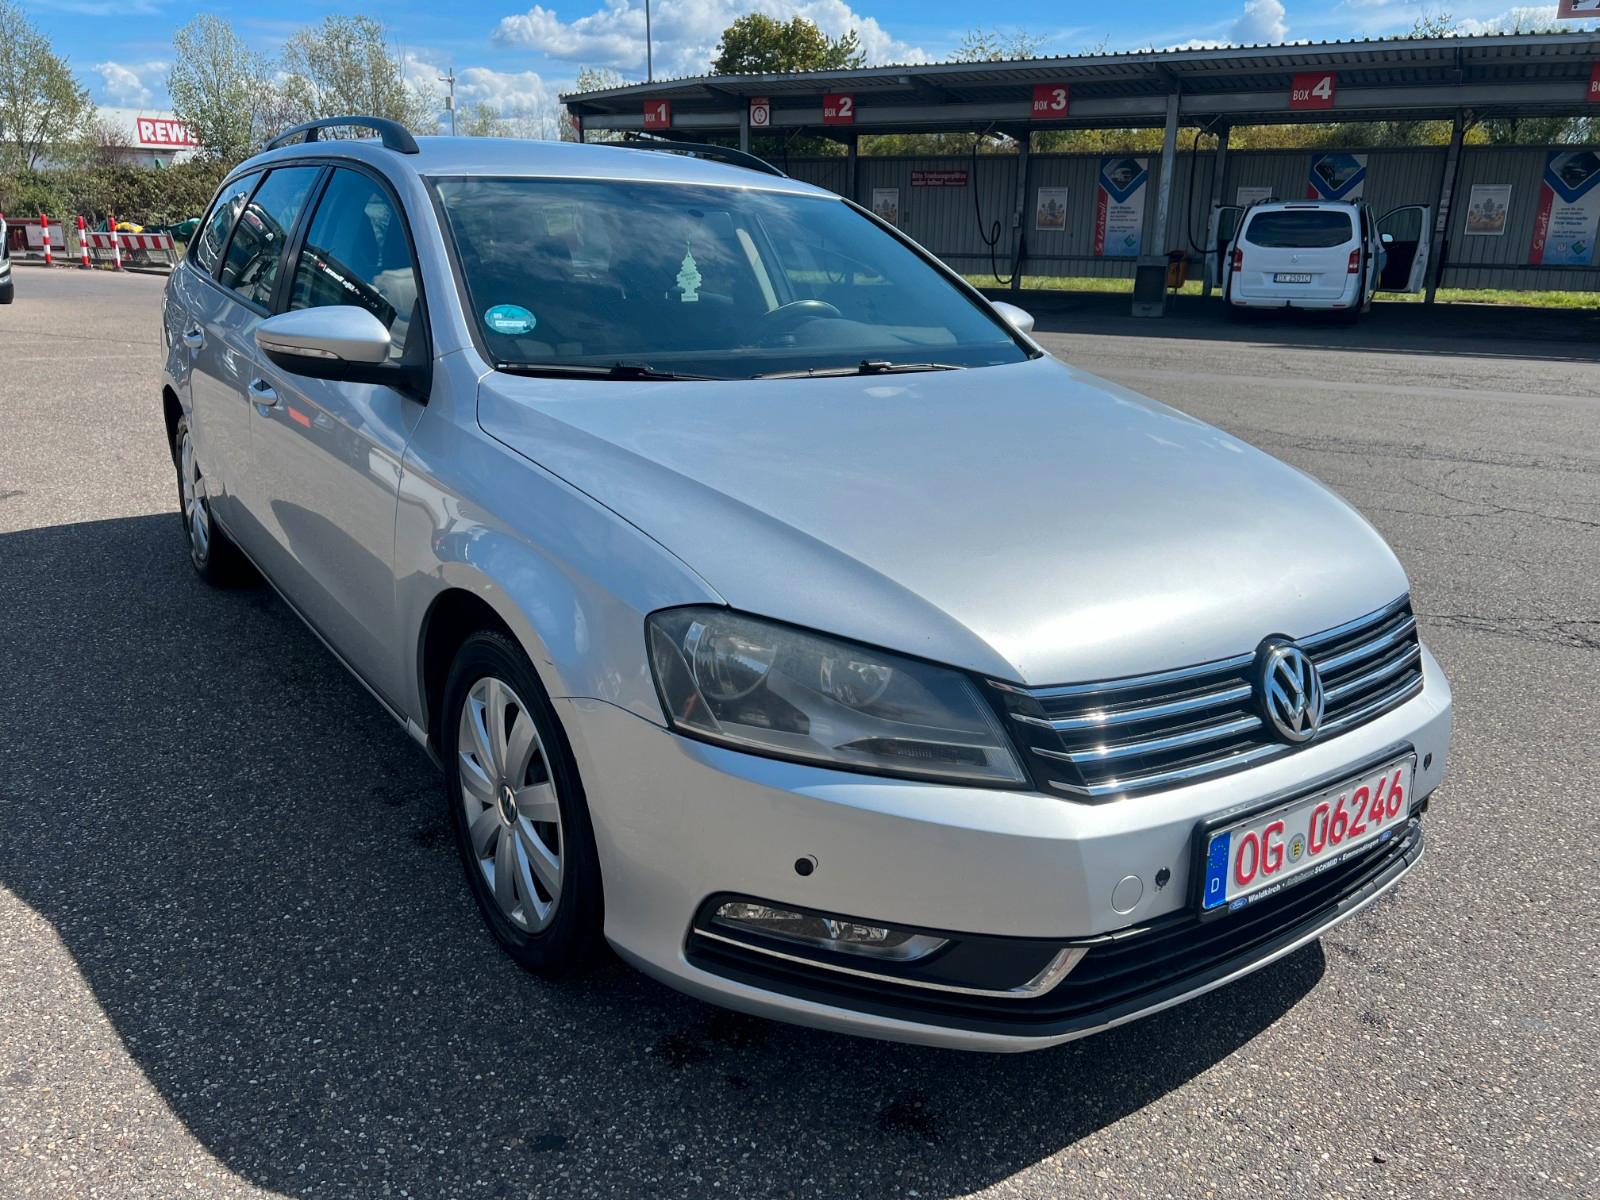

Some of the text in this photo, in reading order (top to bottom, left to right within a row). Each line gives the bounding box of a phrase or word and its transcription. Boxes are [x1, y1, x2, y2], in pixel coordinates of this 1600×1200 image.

[1292, 76, 1332, 100] BOX 4
[824, 96, 852, 117] BOX 2
[1033, 88, 1066, 111] BOX 3
[645, 103, 666, 122] BOX 1
[1234, 769, 1403, 886] OG 06246
[1210, 877, 1220, 894] D
[1248, 883, 1281, 904] Waldkirch
